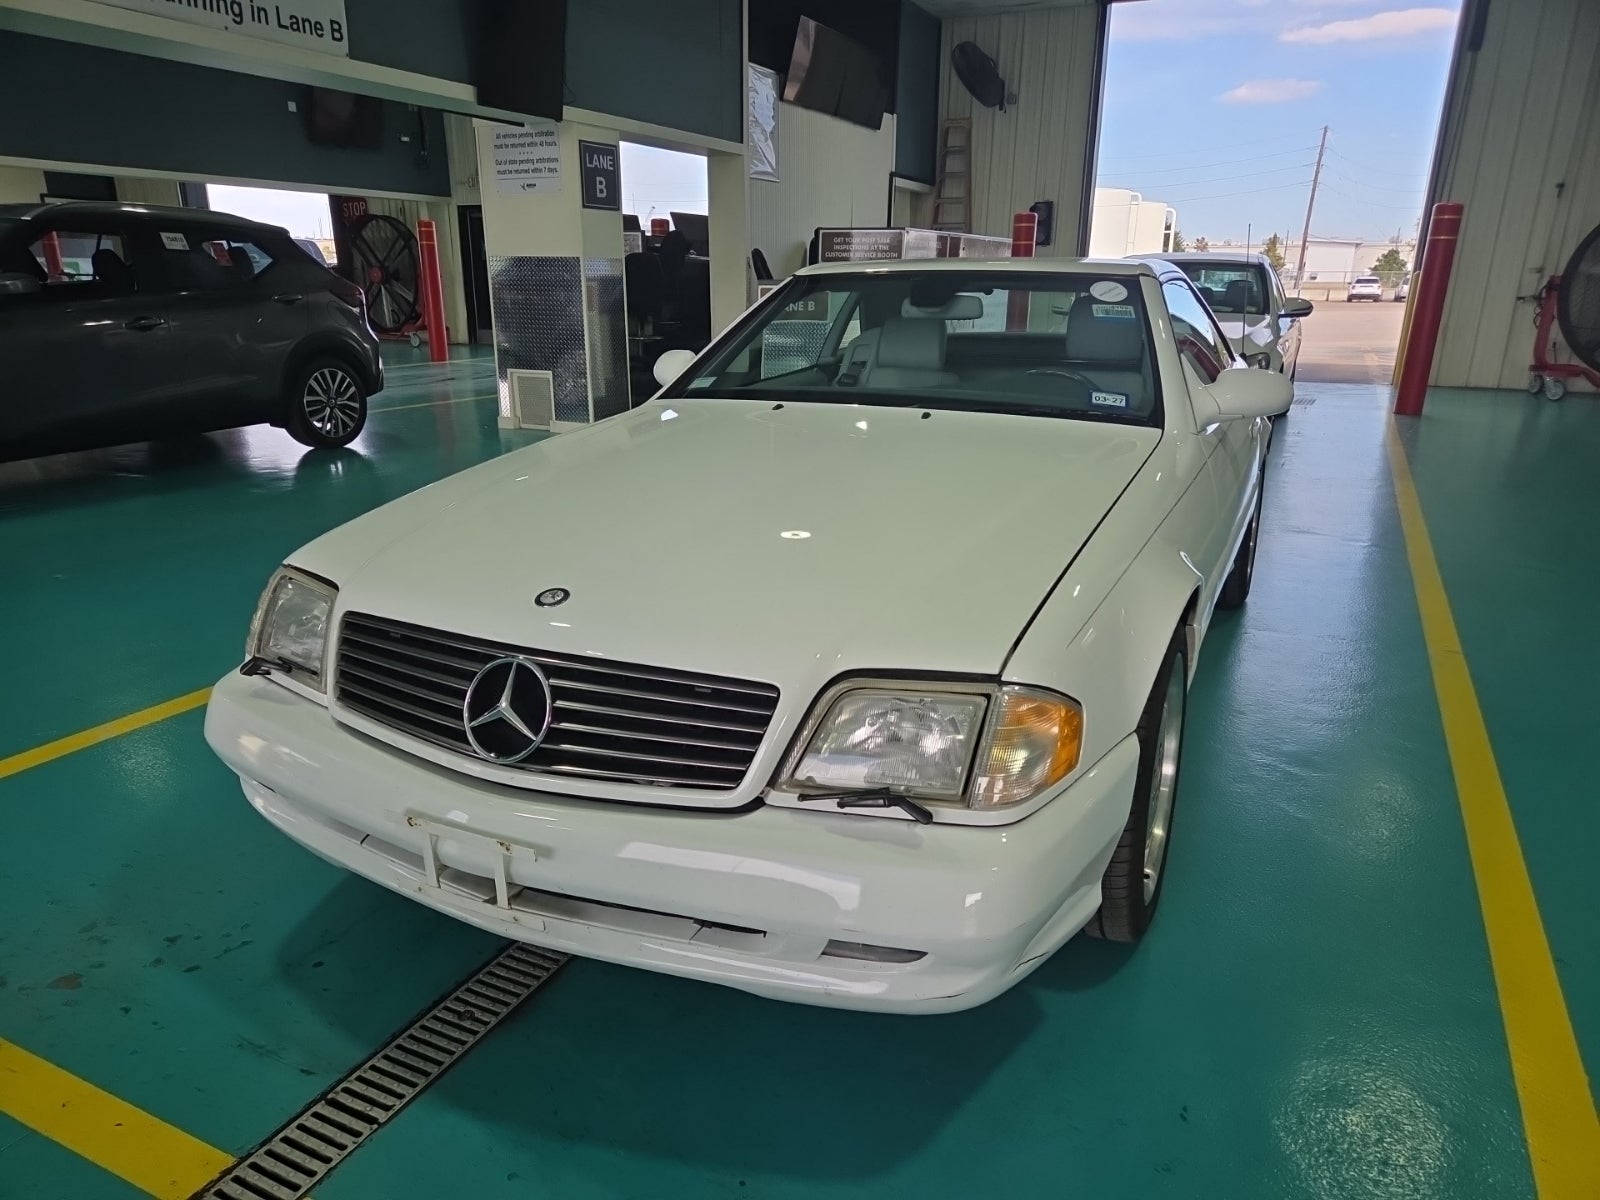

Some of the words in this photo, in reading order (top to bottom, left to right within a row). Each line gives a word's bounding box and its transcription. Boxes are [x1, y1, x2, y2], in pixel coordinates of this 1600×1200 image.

[251, 0, 269, 25] in
[275, 5, 324, 38] Lane
[329, 19, 344, 42] B
[518, 132, 533, 140] pending
[519, 158, 534, 166] pending
[586, 153, 614, 170] LANE
[596, 176, 607, 198] B
[343, 201, 366, 216] STOP
[808, 300, 816, 312] B
